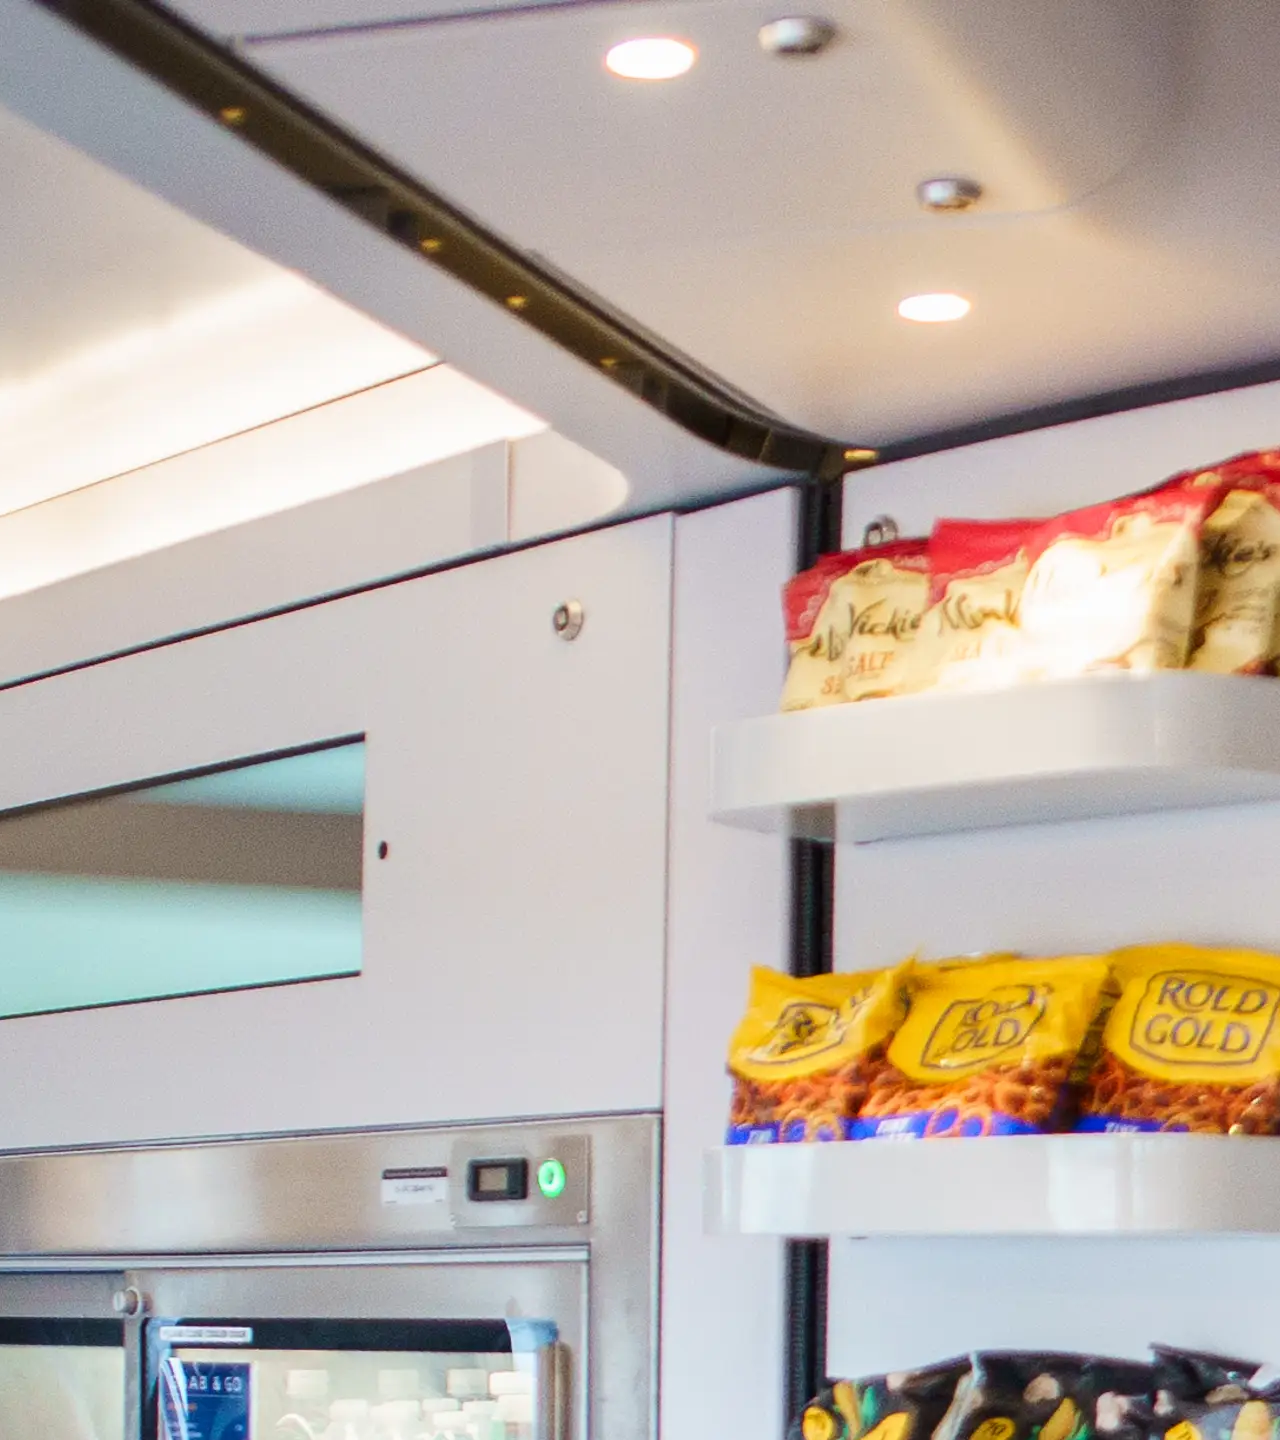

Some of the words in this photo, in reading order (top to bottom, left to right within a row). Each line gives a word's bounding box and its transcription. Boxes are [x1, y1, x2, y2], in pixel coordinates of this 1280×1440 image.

[848, 598, 921, 641] Vickie
[1157, 976, 1269, 1014] ROLD
[933, 1017, 1020, 1057] OLD
[1144, 1013, 1252, 1054] GOLD
[188, 1375, 208, 1391] AB
